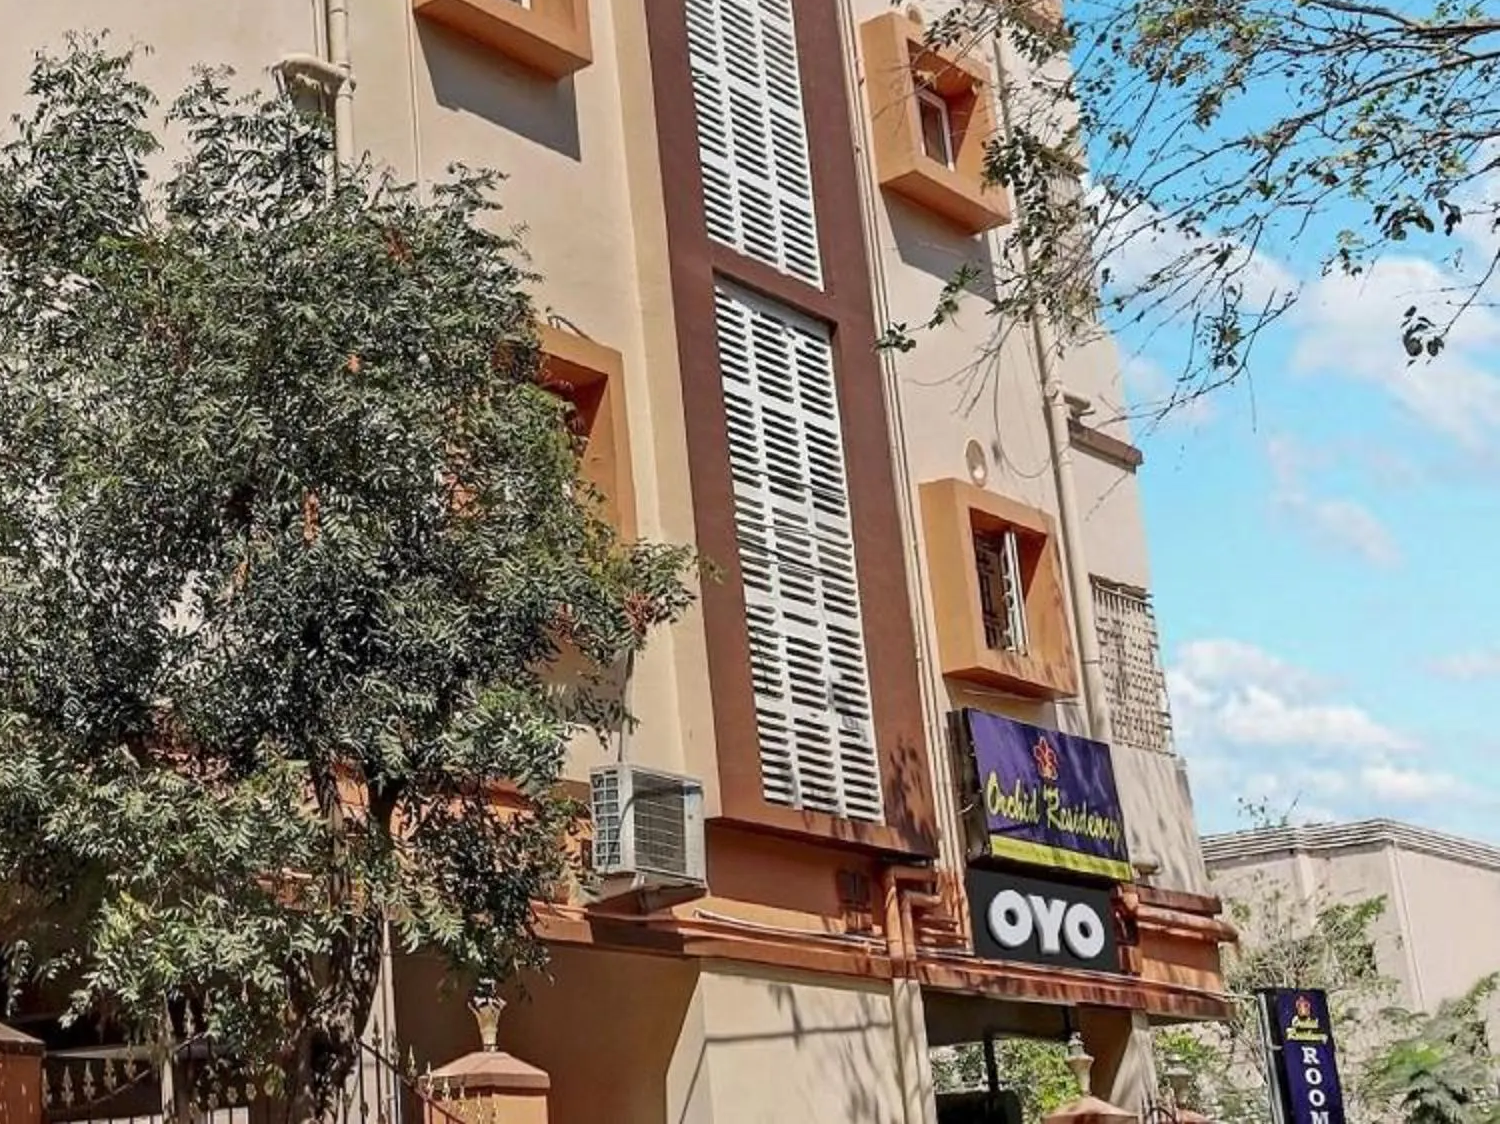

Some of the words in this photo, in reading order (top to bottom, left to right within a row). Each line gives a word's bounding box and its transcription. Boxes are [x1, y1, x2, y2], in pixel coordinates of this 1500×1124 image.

[987, 771, 1041, 824] Orchid
[1043, 783, 1121, 853] Residency
[988, 889, 1105, 959] OYO
